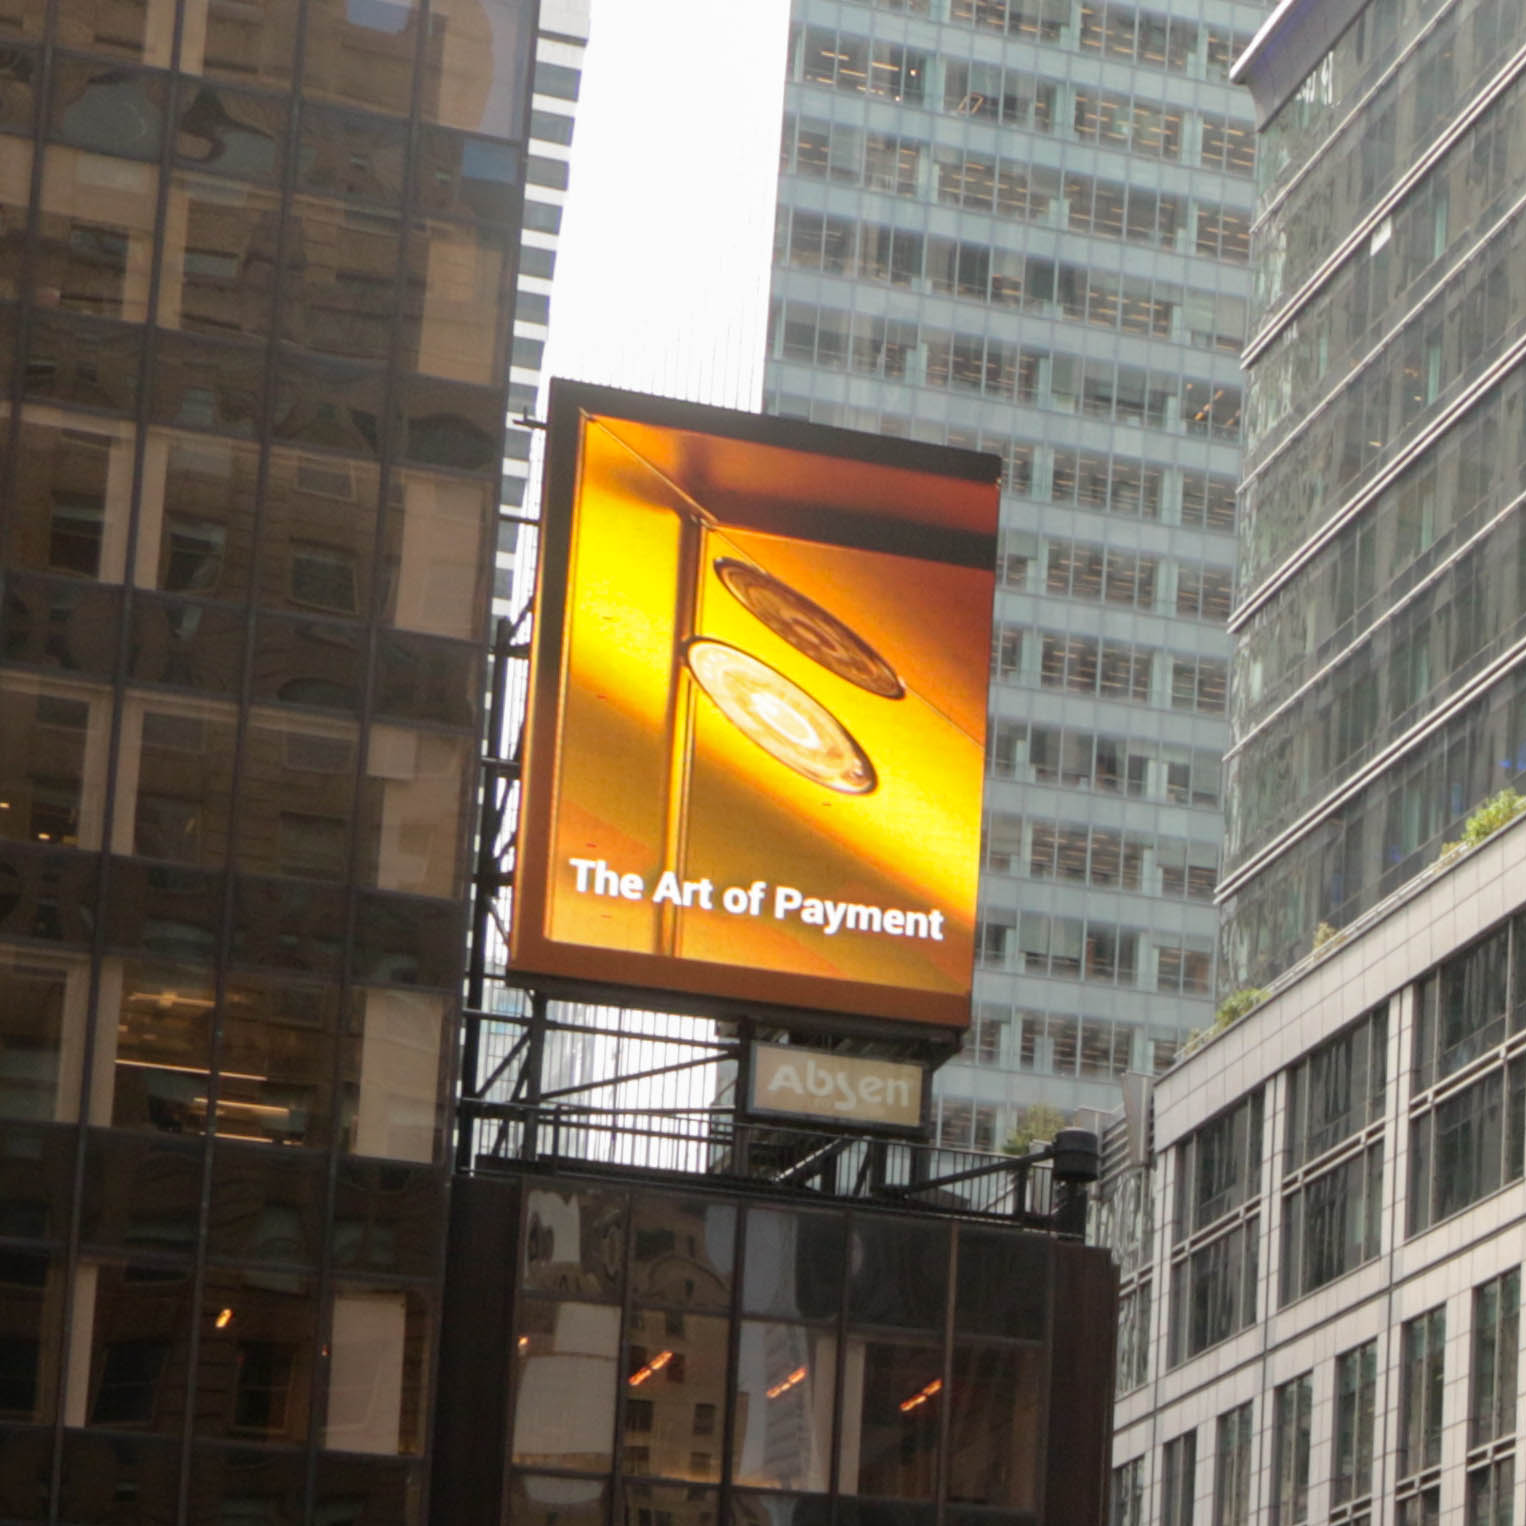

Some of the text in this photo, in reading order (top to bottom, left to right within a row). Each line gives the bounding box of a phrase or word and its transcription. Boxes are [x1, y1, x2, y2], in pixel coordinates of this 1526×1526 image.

[569, 857, 946, 940] The Art of Payment
[767, 1060, 910, 1111] Absen
